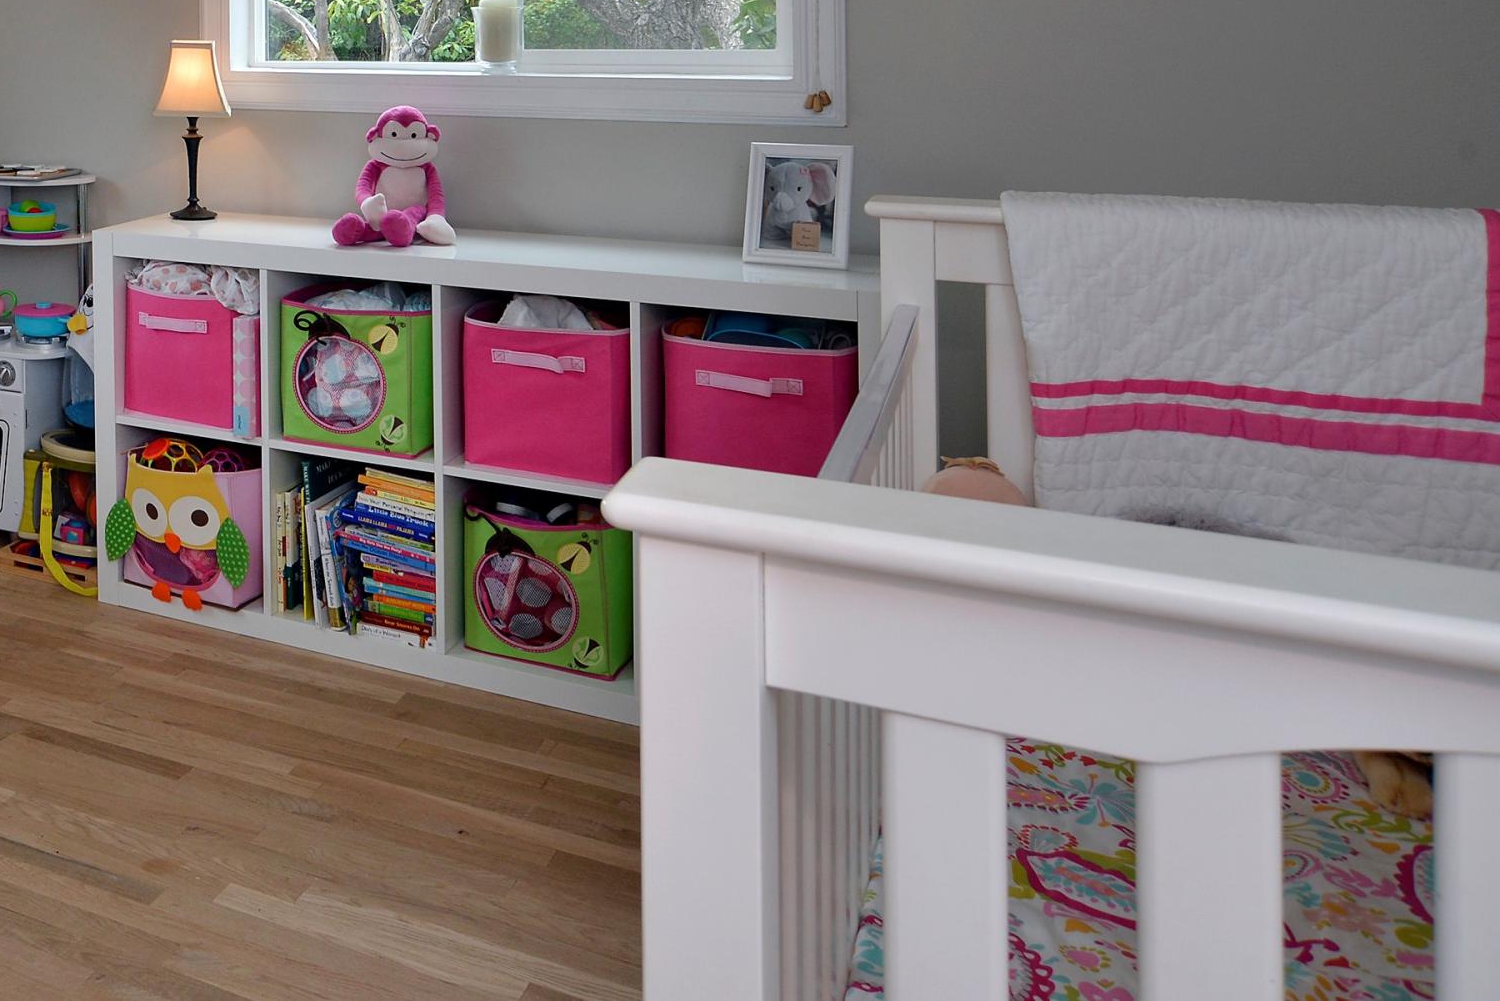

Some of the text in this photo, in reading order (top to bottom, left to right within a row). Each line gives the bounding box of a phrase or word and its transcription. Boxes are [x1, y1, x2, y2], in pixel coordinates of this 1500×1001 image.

[368, 506, 430, 527] Little Blue Truck
